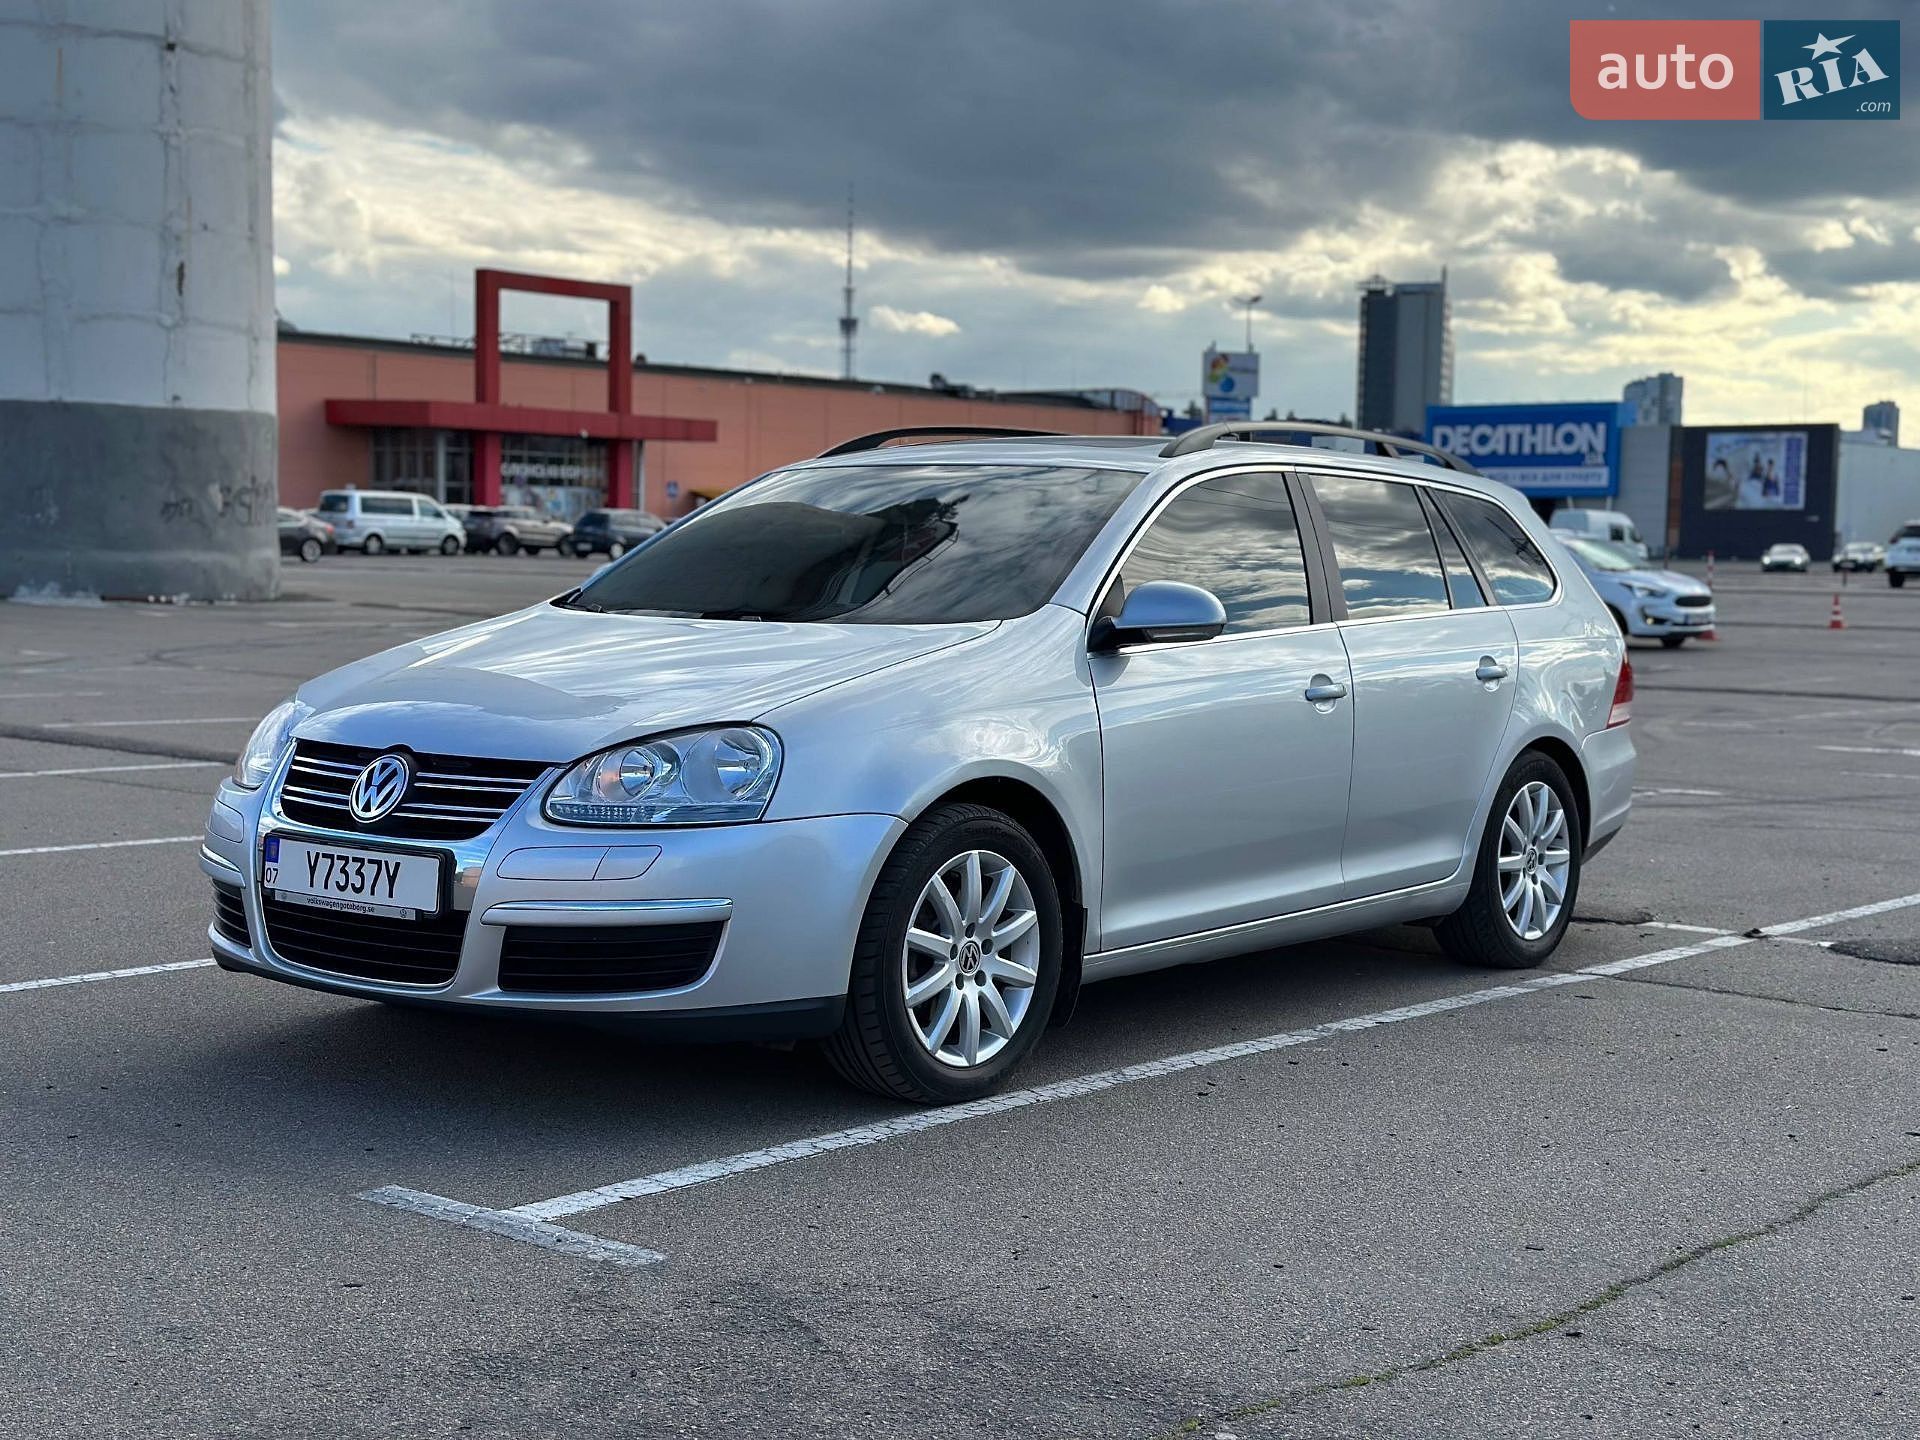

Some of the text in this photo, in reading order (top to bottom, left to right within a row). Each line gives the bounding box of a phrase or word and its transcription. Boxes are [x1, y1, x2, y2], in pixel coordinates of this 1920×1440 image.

[1432, 422, 1608, 457] DECATHLON
[265, 867, 279, 884] 07
[306, 850, 401, 899] Y7337Y
